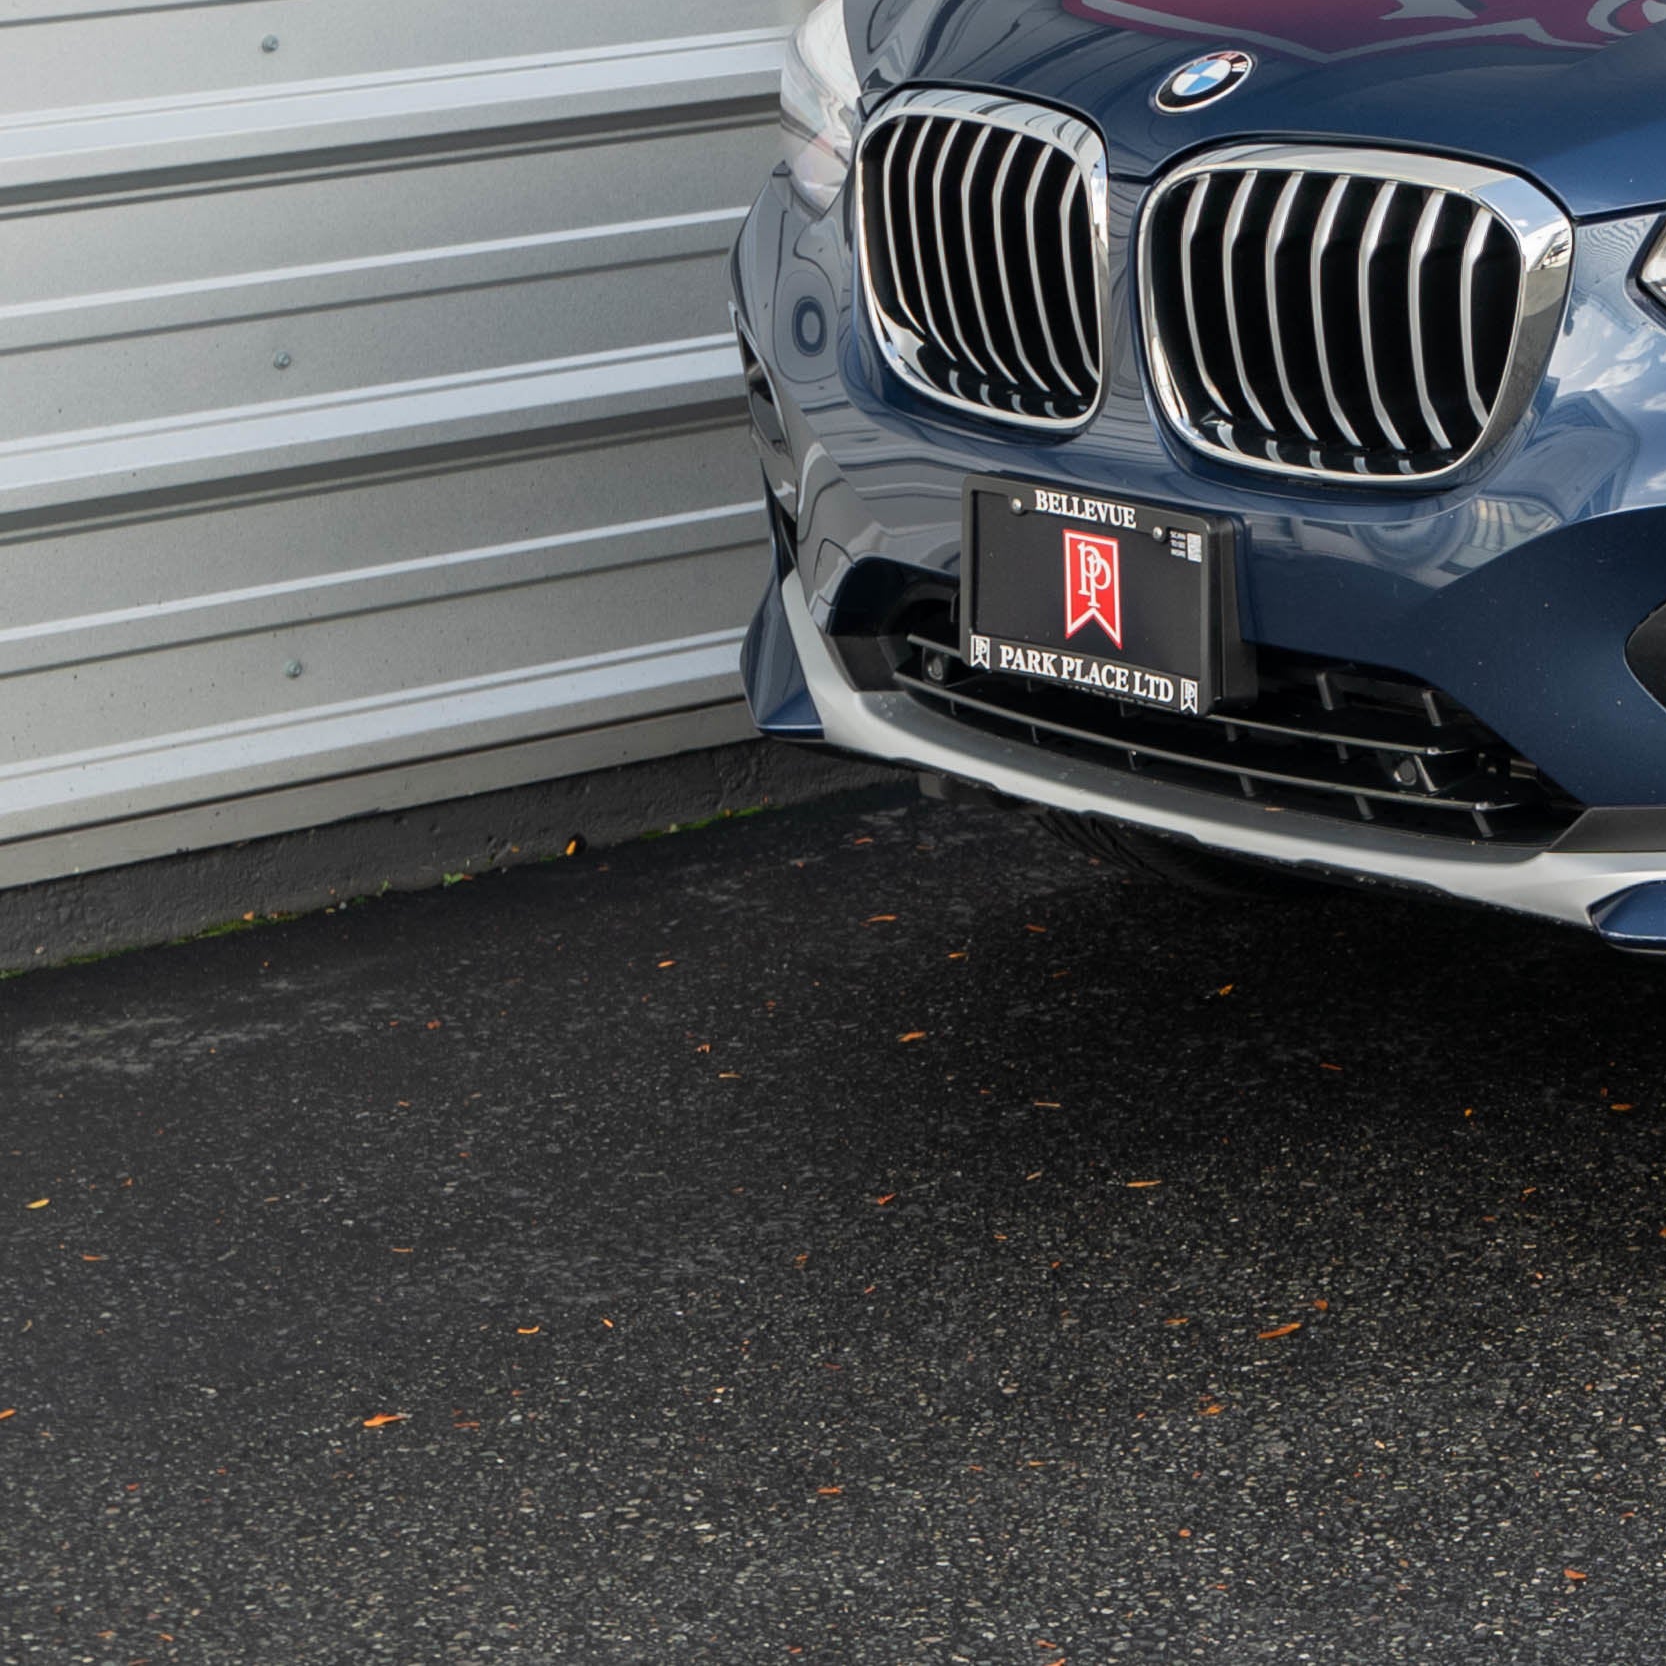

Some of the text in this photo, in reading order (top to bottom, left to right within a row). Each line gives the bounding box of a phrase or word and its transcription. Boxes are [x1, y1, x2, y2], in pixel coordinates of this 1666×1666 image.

[1034, 489, 1136, 529] BELLEVUE
[1000, 644, 1057, 678] PARK
[1061, 655, 1129, 692] PLACE
[1133, 671, 1174, 703] LTD
